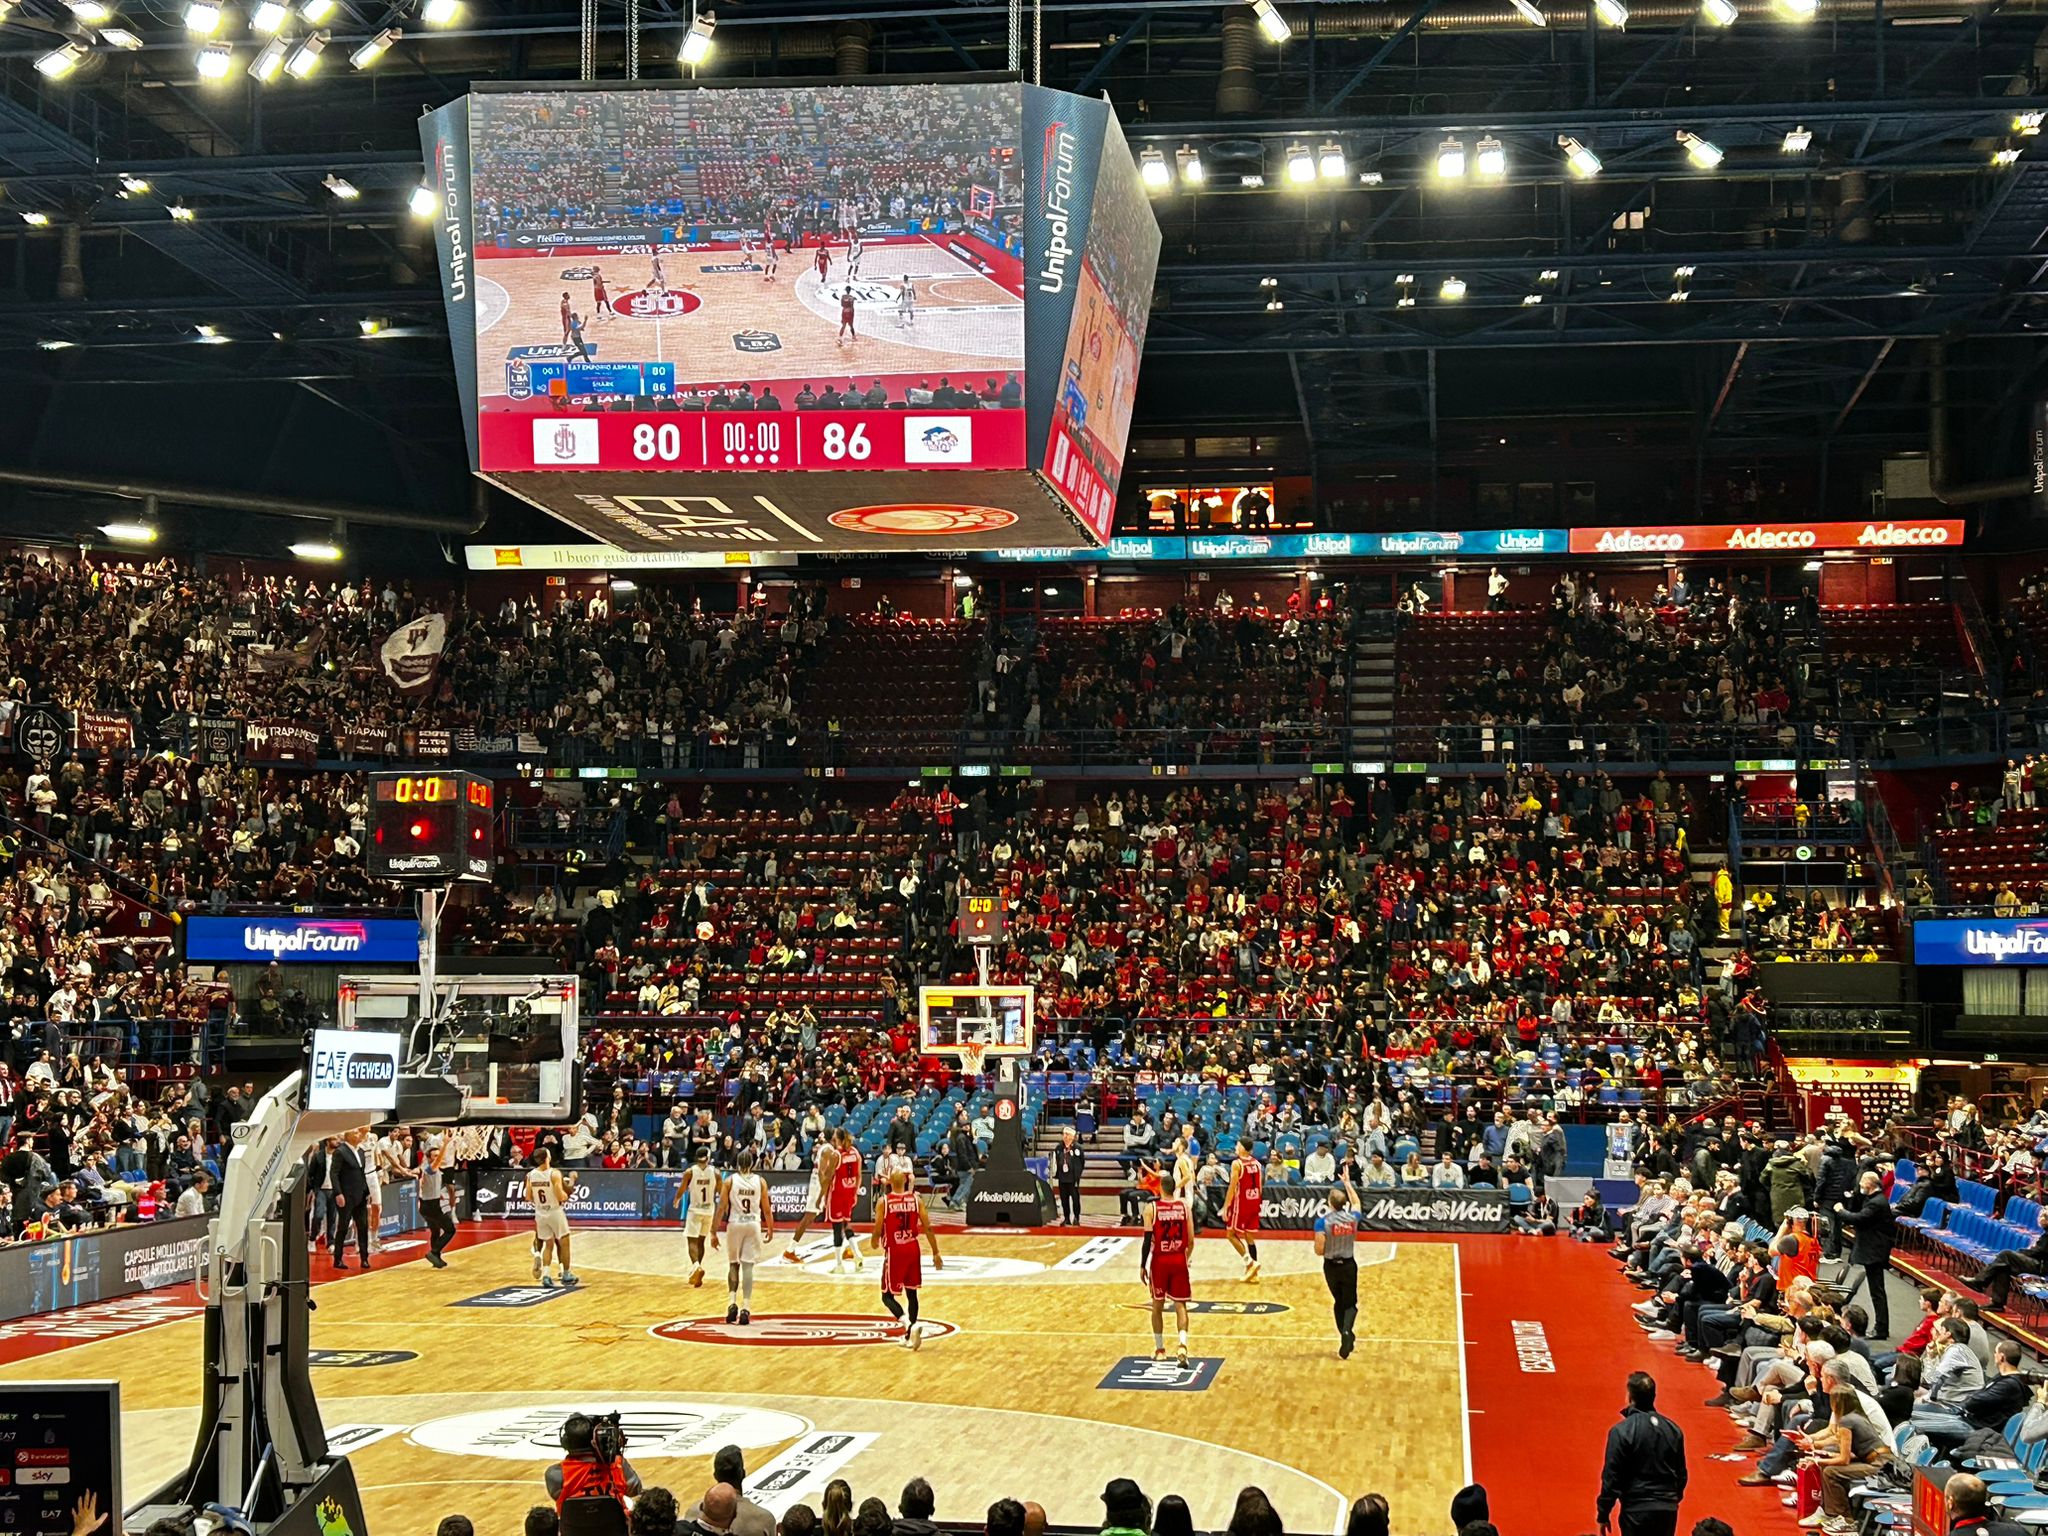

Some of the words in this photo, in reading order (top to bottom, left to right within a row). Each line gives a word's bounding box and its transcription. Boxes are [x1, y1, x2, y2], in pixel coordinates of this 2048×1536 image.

[1041, 132, 1075, 293] UnipolForum
[443, 145, 466, 302] UnipolForum
[633, 423, 681, 461] 80
[723, 422, 779, 452] 00:00
[823, 423, 871, 460] 86
[2034, 430, 2046, 493] UnipolForum
[1500, 531, 1543, 550] Unipol
[1595, 530, 1684, 551] Adecco
[1726, 527, 1815, 548] Adecco
[1857, 523, 1947, 545] Adecco
[1112, 539, 1152, 559] Unipol
[1193, 540, 1268, 559] UnipolForum
[1310, 535, 1350, 556] Unipol
[1382, 537, 1458, 555] UnipolForum
[553, 550, 563, 562] Il
[567, 550, 600, 563] buon
[604, 553, 638, 566] gusto
[343, 725, 387, 738] TRAPANI
[396, 777, 441, 802] 0:0
[969, 899, 992, 912] 0:0
[244, 927, 359, 958] UnipolForum
[315, 1051, 346, 1079] EA7
[348, 1061, 392, 1079] EYEWEAR
[538, 1189, 547, 1204] 6
[701, 1187, 706, 1202] 1
[771, 1186, 807, 1195] CAPSULE
[594, 1201, 602, 1210] IL
[603, 1201, 637, 1210] DOLORE
[742, 1199, 751, 1214] 9
[124, 1246, 156, 1266] CAPSULE
[156, 1242, 176, 1259] MOLLI
[1161, 1240, 1183, 1252] EA7
[125, 1264, 150, 1283] DOLORI
[151, 1256, 188, 1276] ARTICOLARI
[31, 1470, 54, 1482] sky
[41, 1510, 61, 1518] EA7
